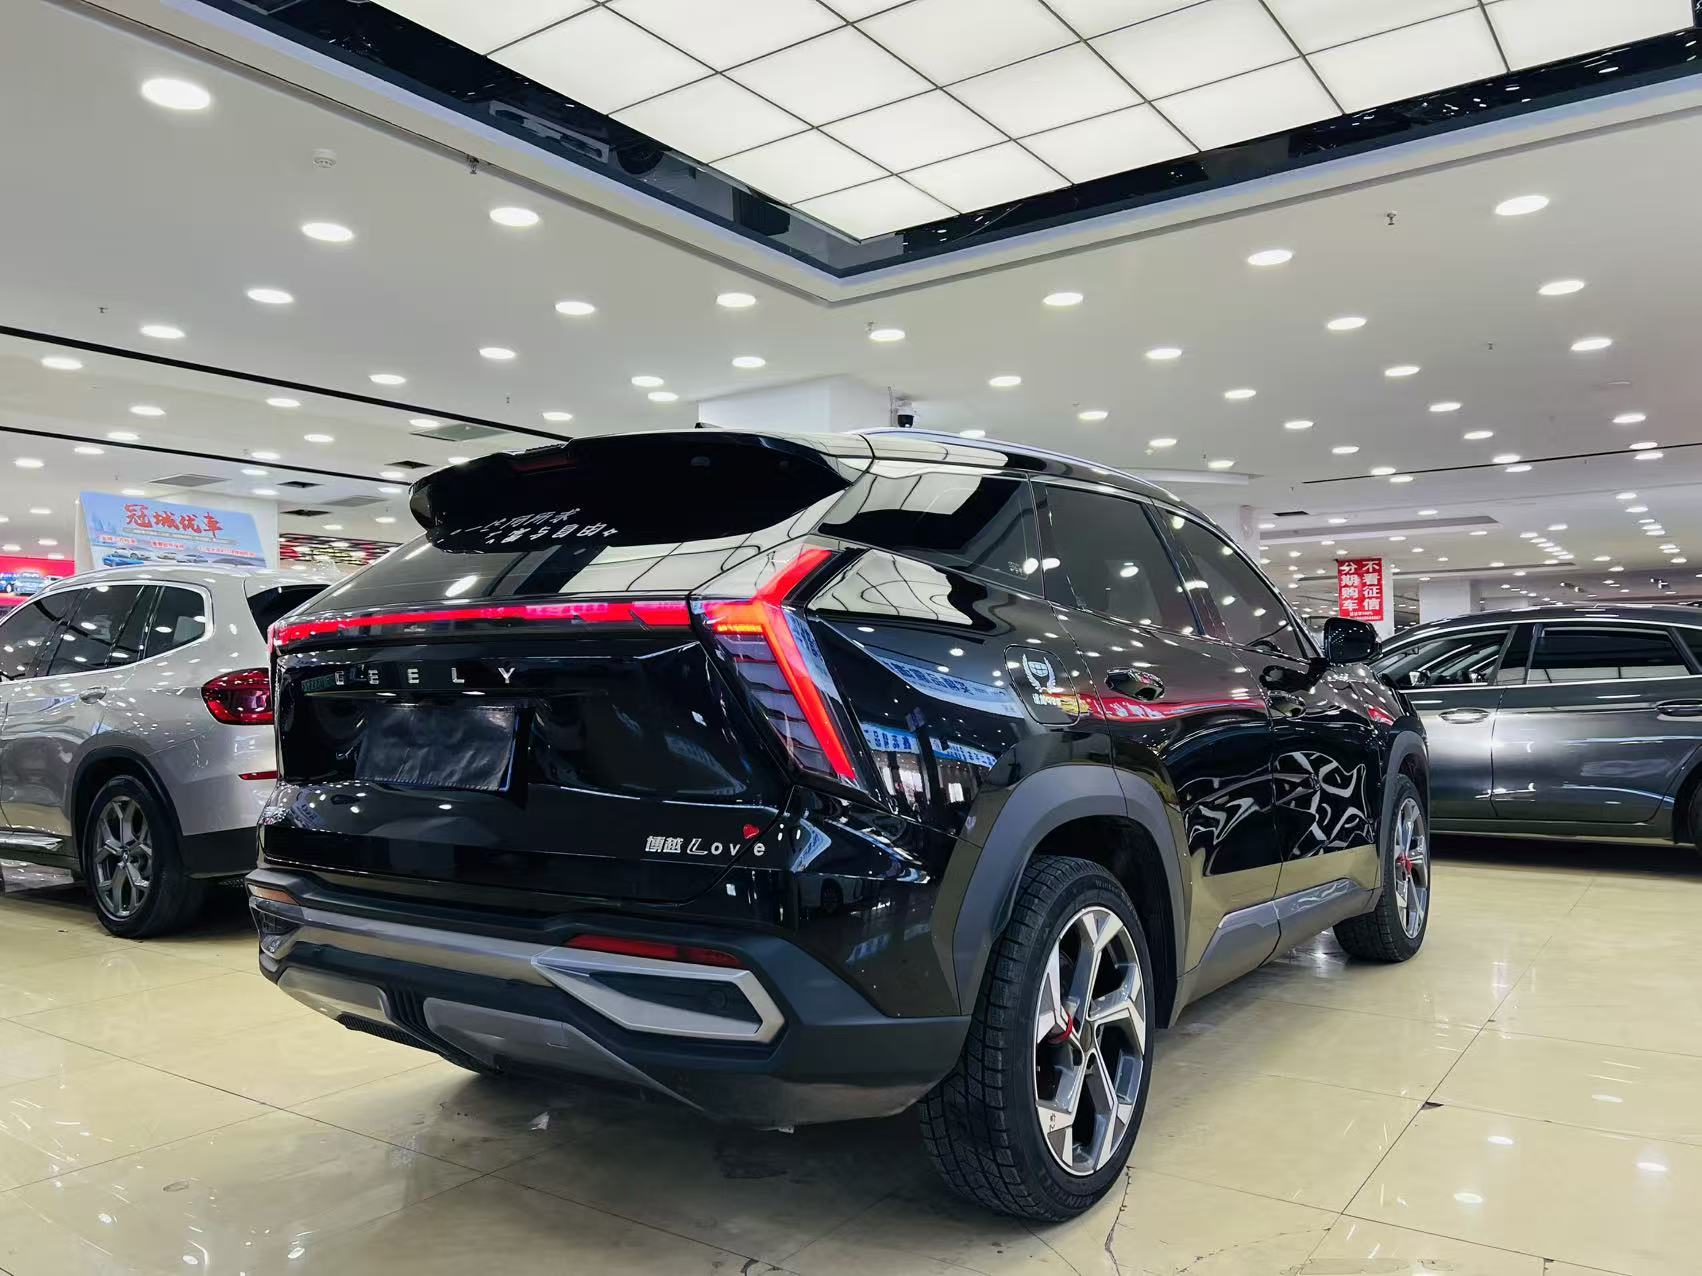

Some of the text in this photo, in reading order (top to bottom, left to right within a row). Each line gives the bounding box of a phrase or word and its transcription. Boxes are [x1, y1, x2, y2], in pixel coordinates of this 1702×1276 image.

[124, 503, 224, 538] 冠城优车
[1339, 562, 1360, 611] 分期购车
[1362, 560, 1381, 611] 不看征信
[334, 667, 515, 686] GEELY
[645, 835, 684, 853] 博越
